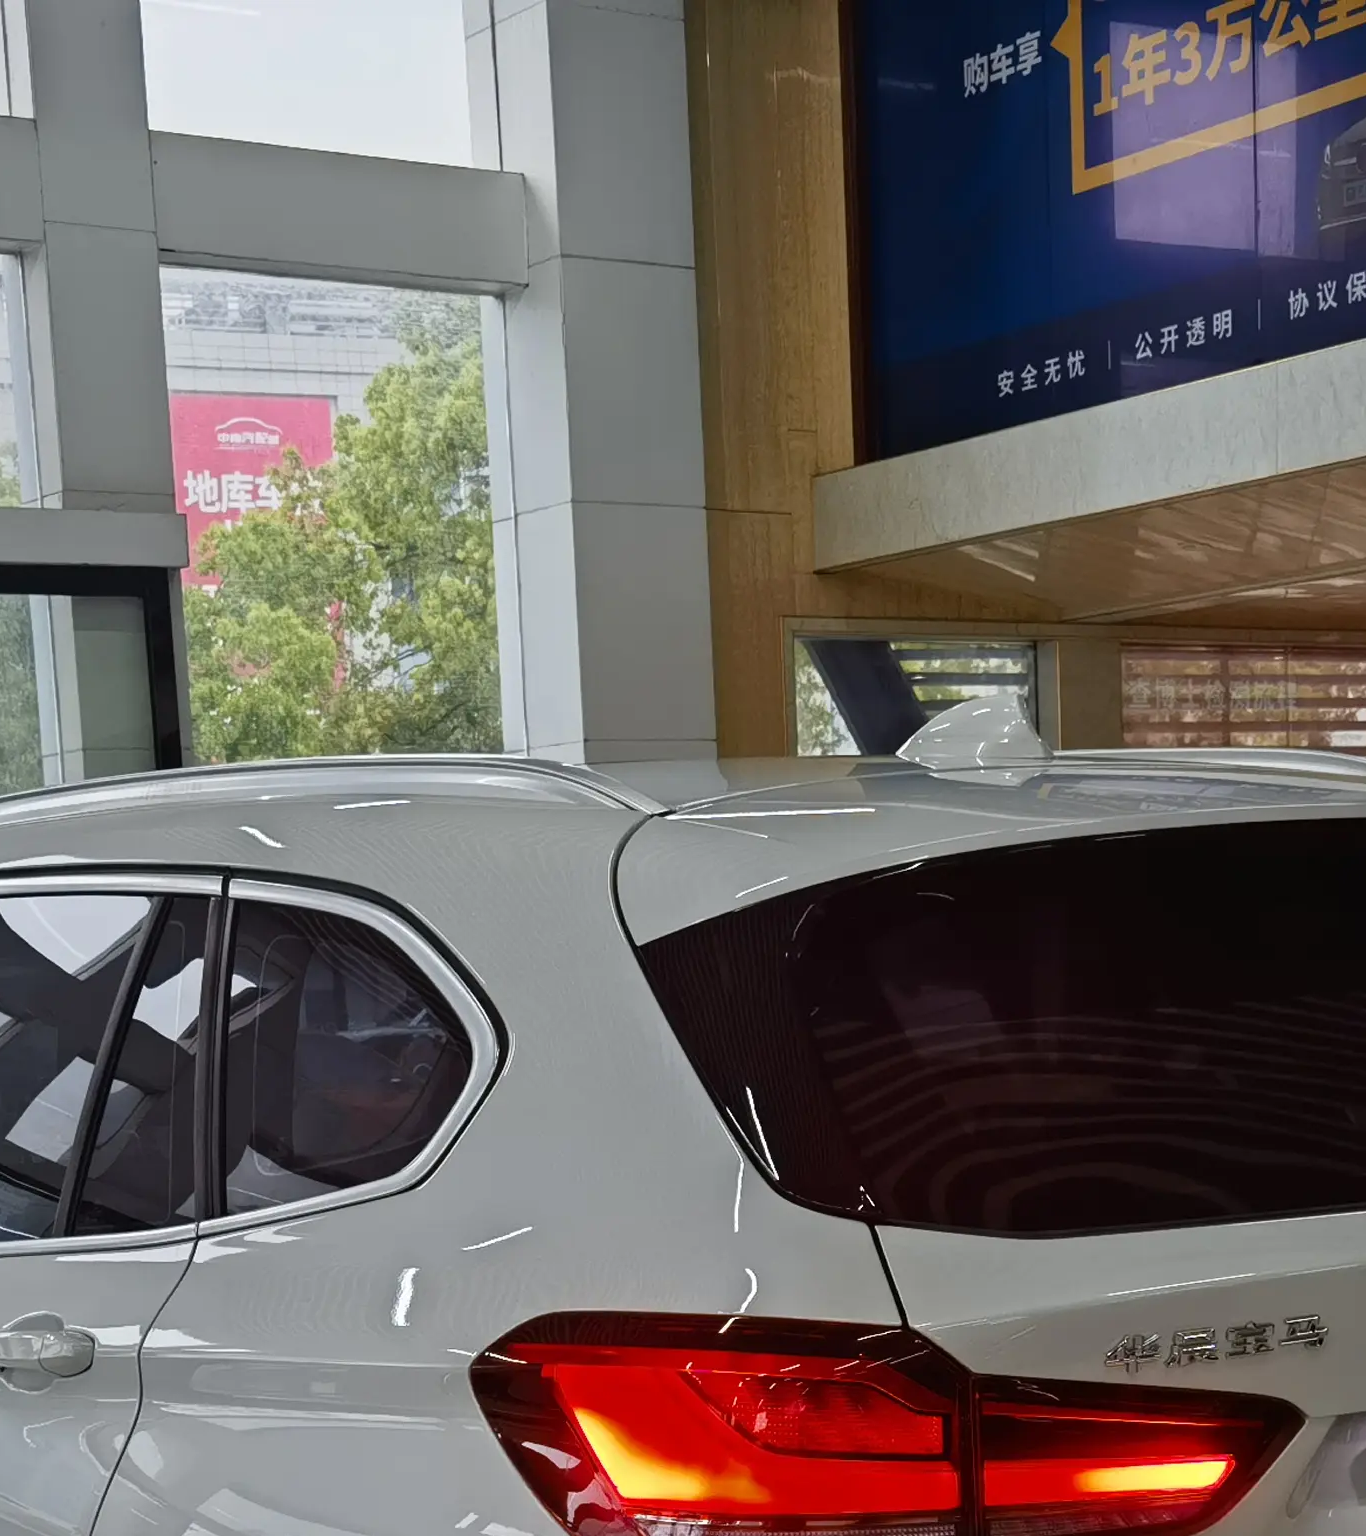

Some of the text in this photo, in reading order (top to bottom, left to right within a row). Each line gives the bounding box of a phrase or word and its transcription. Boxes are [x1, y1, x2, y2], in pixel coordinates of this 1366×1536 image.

[962, 29, 1042, 98] 购车享
[997, 349, 1086, 398] 安全无忧
[1134, 308, 1234, 362] 公开透明
[1104, 1313, 1329, 1374] 华晨宝马
